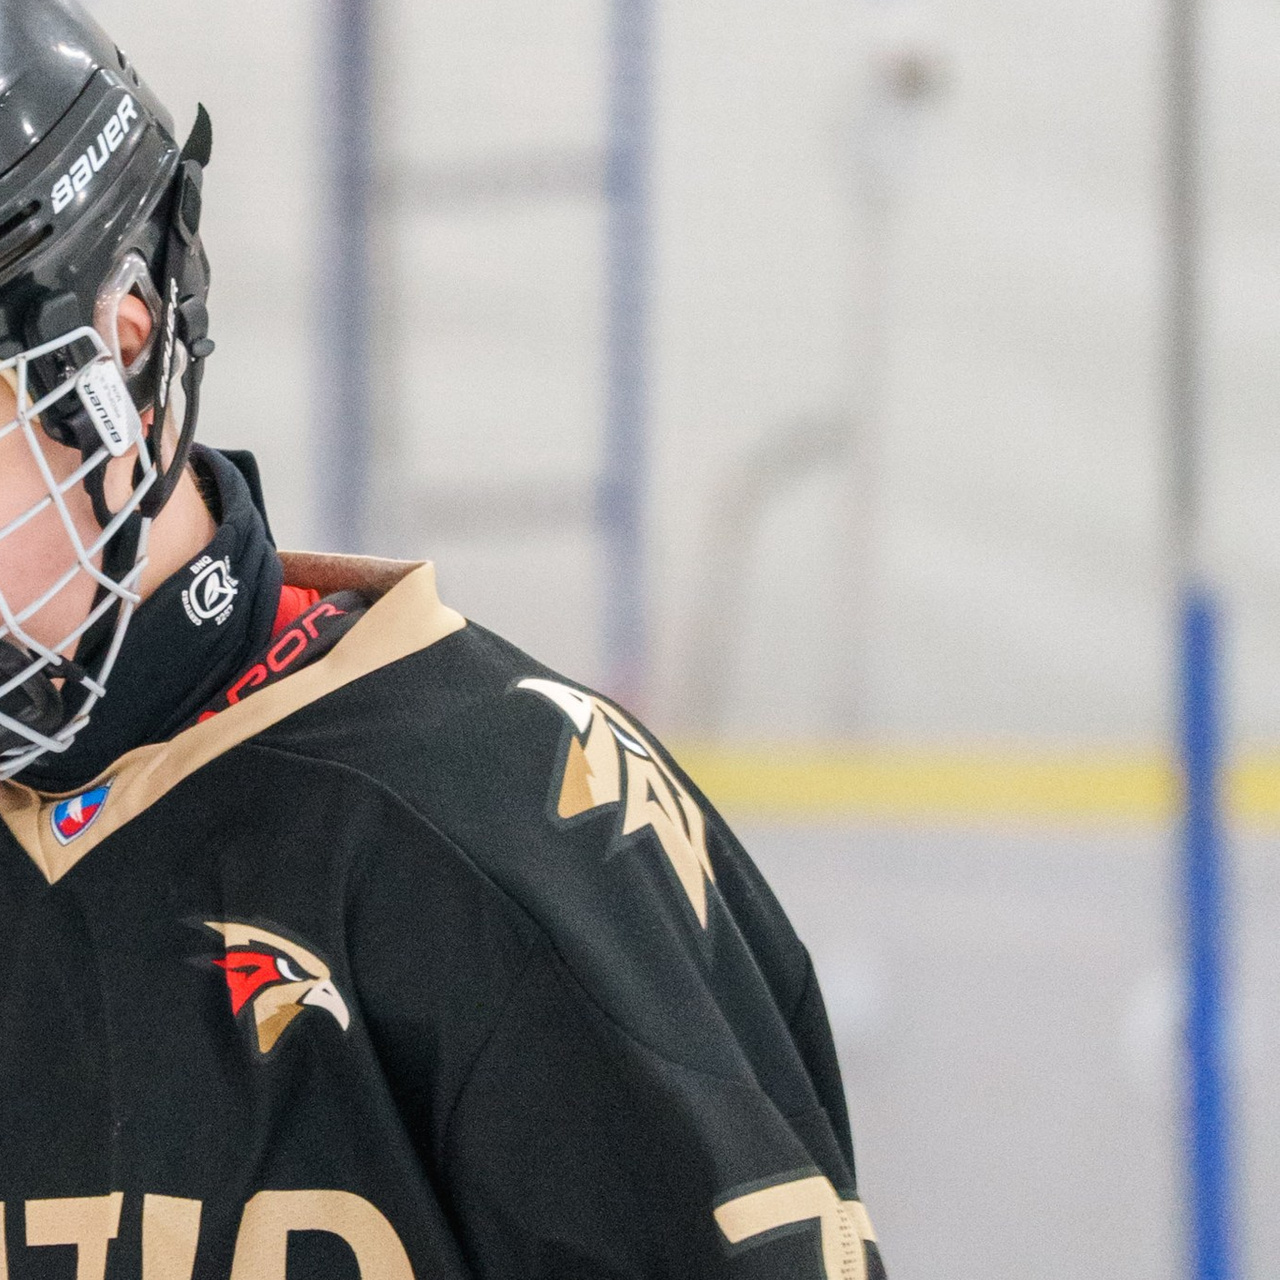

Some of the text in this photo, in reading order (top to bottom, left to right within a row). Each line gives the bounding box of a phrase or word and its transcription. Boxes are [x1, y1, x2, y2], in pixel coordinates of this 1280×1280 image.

[50, 93, 139, 215] BAUER
[83, 383, 122, 444] BAUER
[189, 555, 214, 575] BNQ
[192, 602, 347, 727] POR
